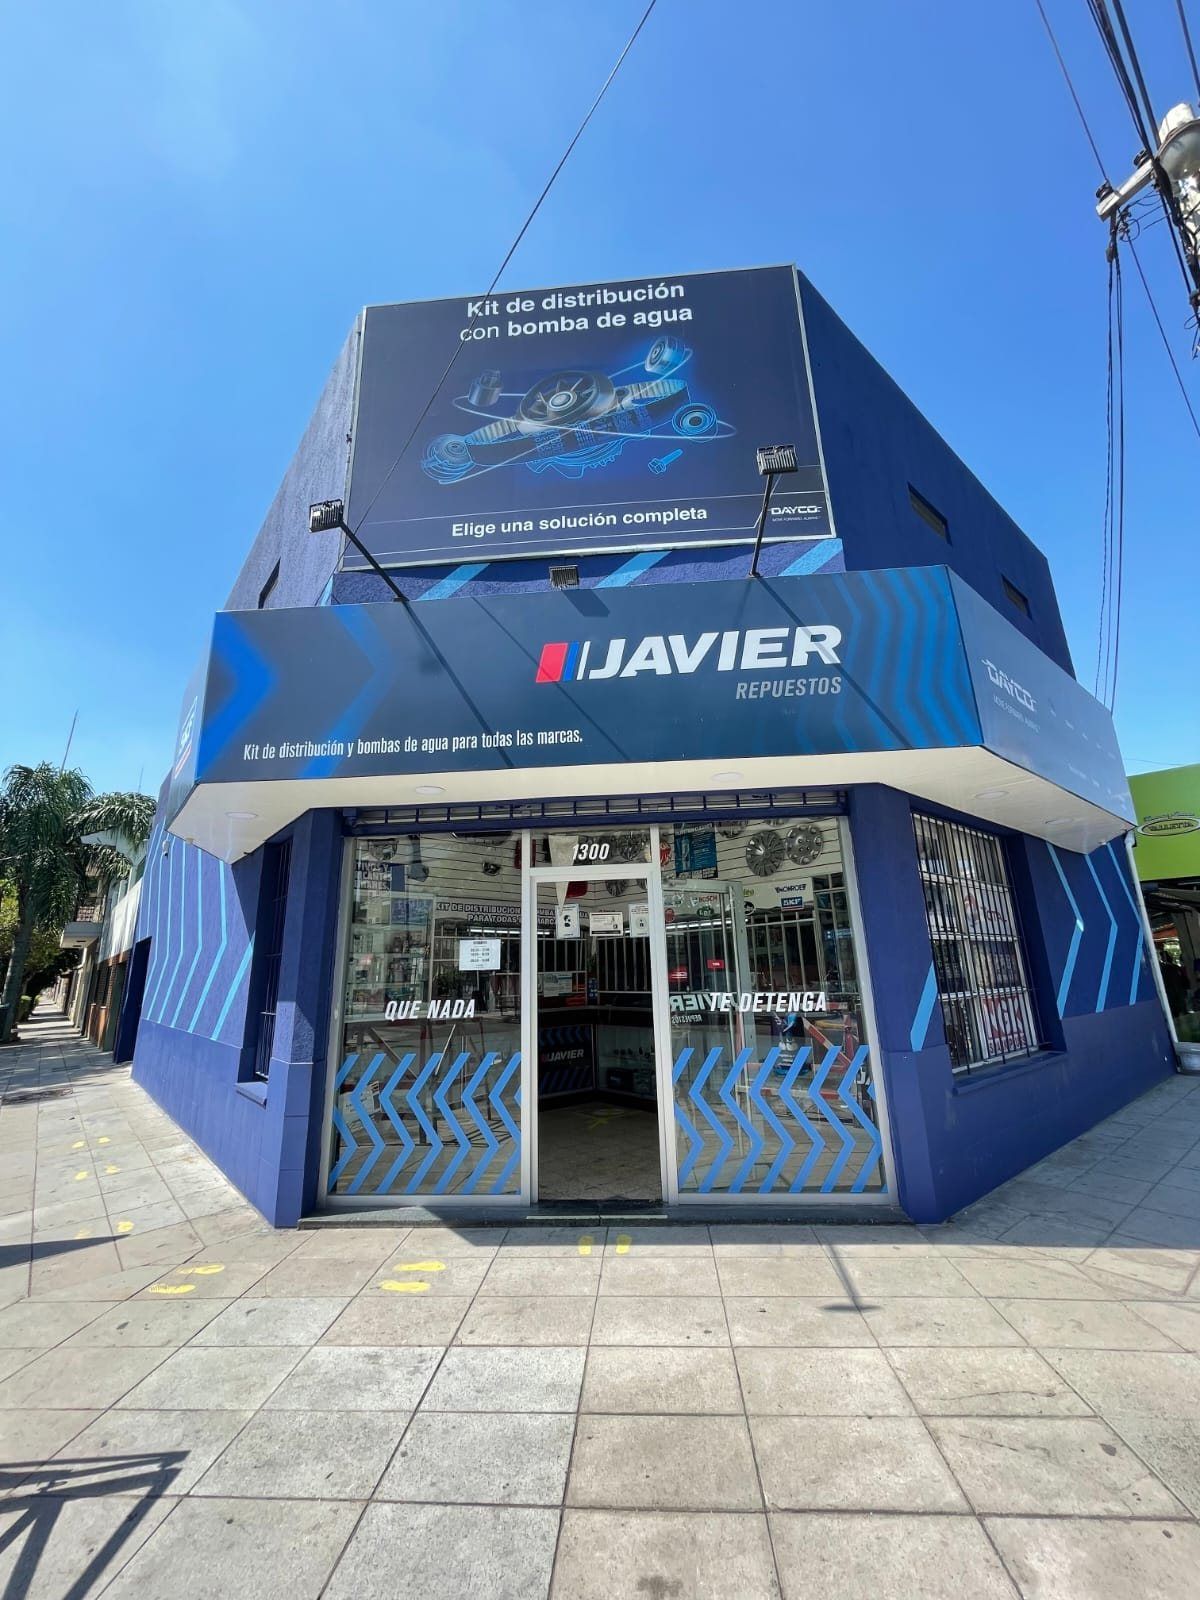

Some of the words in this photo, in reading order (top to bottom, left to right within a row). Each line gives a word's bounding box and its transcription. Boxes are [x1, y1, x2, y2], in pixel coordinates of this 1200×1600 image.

[467, 300, 499, 318] Kit
[506, 297, 535, 314] de
[541, 282, 685, 310] distribución
[460, 325, 499, 341] con
[508, 316, 589, 337] bomba
[597, 312, 626, 328] de
[633, 308, 693, 328] agua
[770, 505, 819, 515] DAYCO
[452, 522, 496, 538] Elige
[501, 521, 534, 533] una
[539, 512, 617, 530] solución
[622, 507, 708, 525] completa
[589, 625, 842, 680] JAVIER
[735, 676, 842, 700] REPUESTOS
[243, 744, 259, 760] Kit
[262, 743, 276, 759] de
[279, 740, 344, 758] distribución
[347, 742, 354, 757] y
[357, 737, 401, 754] bombas
[404, 736, 418, 752] de
[421, 737, 449, 753] agua
[452, 735, 478, 752] para
[481, 731, 513, 748] todas
[516, 730, 533, 746] las
[537, 729, 583, 745] marcas.
[572, 843, 610, 861] 1300
[436, 902, 450, 911] KIT
[451, 903, 464, 912] DE
[467, 914, 490, 922] PARA
[491, 915, 517, 923] TODAS
[385, 1000, 421, 1021] QUE
[427, 999, 475, 1019] NADA
[710, 991, 733, 1012] TE
[739, 991, 827, 1012] DETENGA
[548, 1049, 585, 1062] JAVIER
